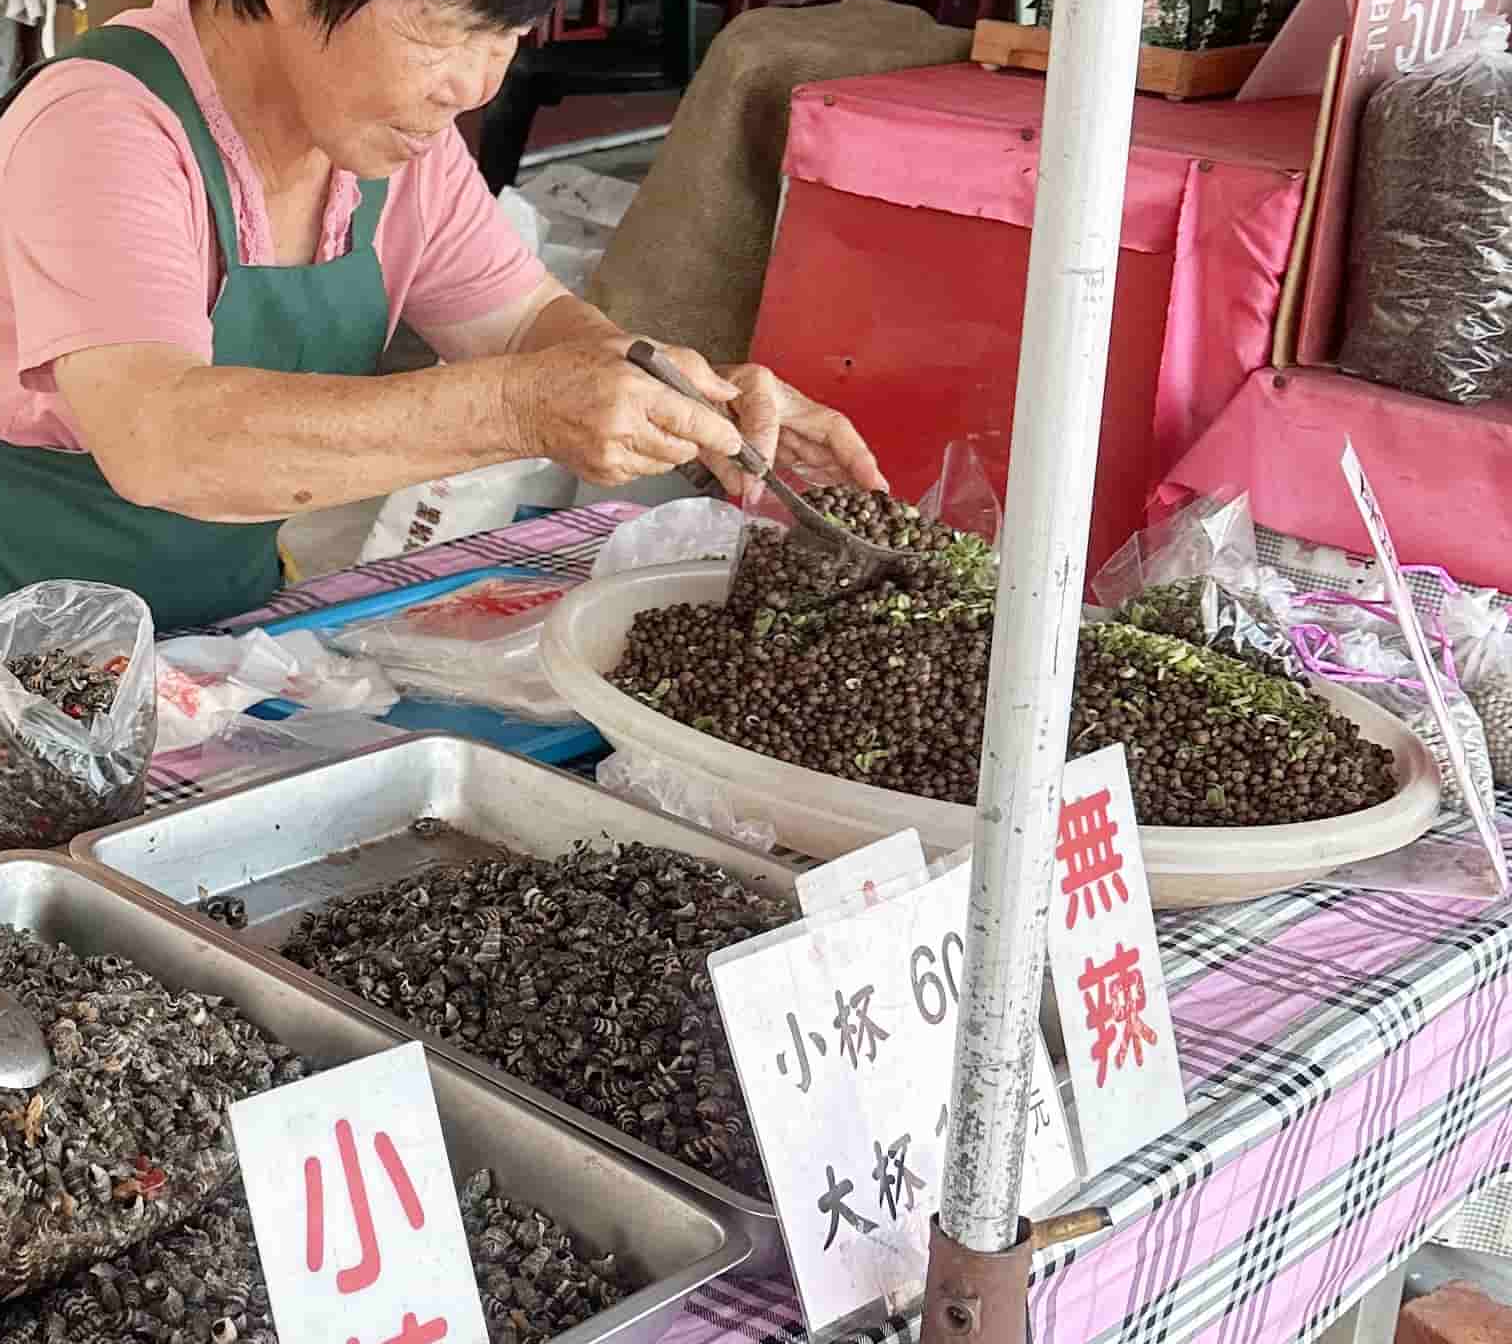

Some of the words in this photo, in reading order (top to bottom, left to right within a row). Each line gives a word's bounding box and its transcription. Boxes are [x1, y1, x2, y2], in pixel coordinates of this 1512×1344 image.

[1056, 788, 1157, 1087] 無辣
[776, 983, 890, 1093] 小杯
[817, 1133, 926, 1252] 大杯
